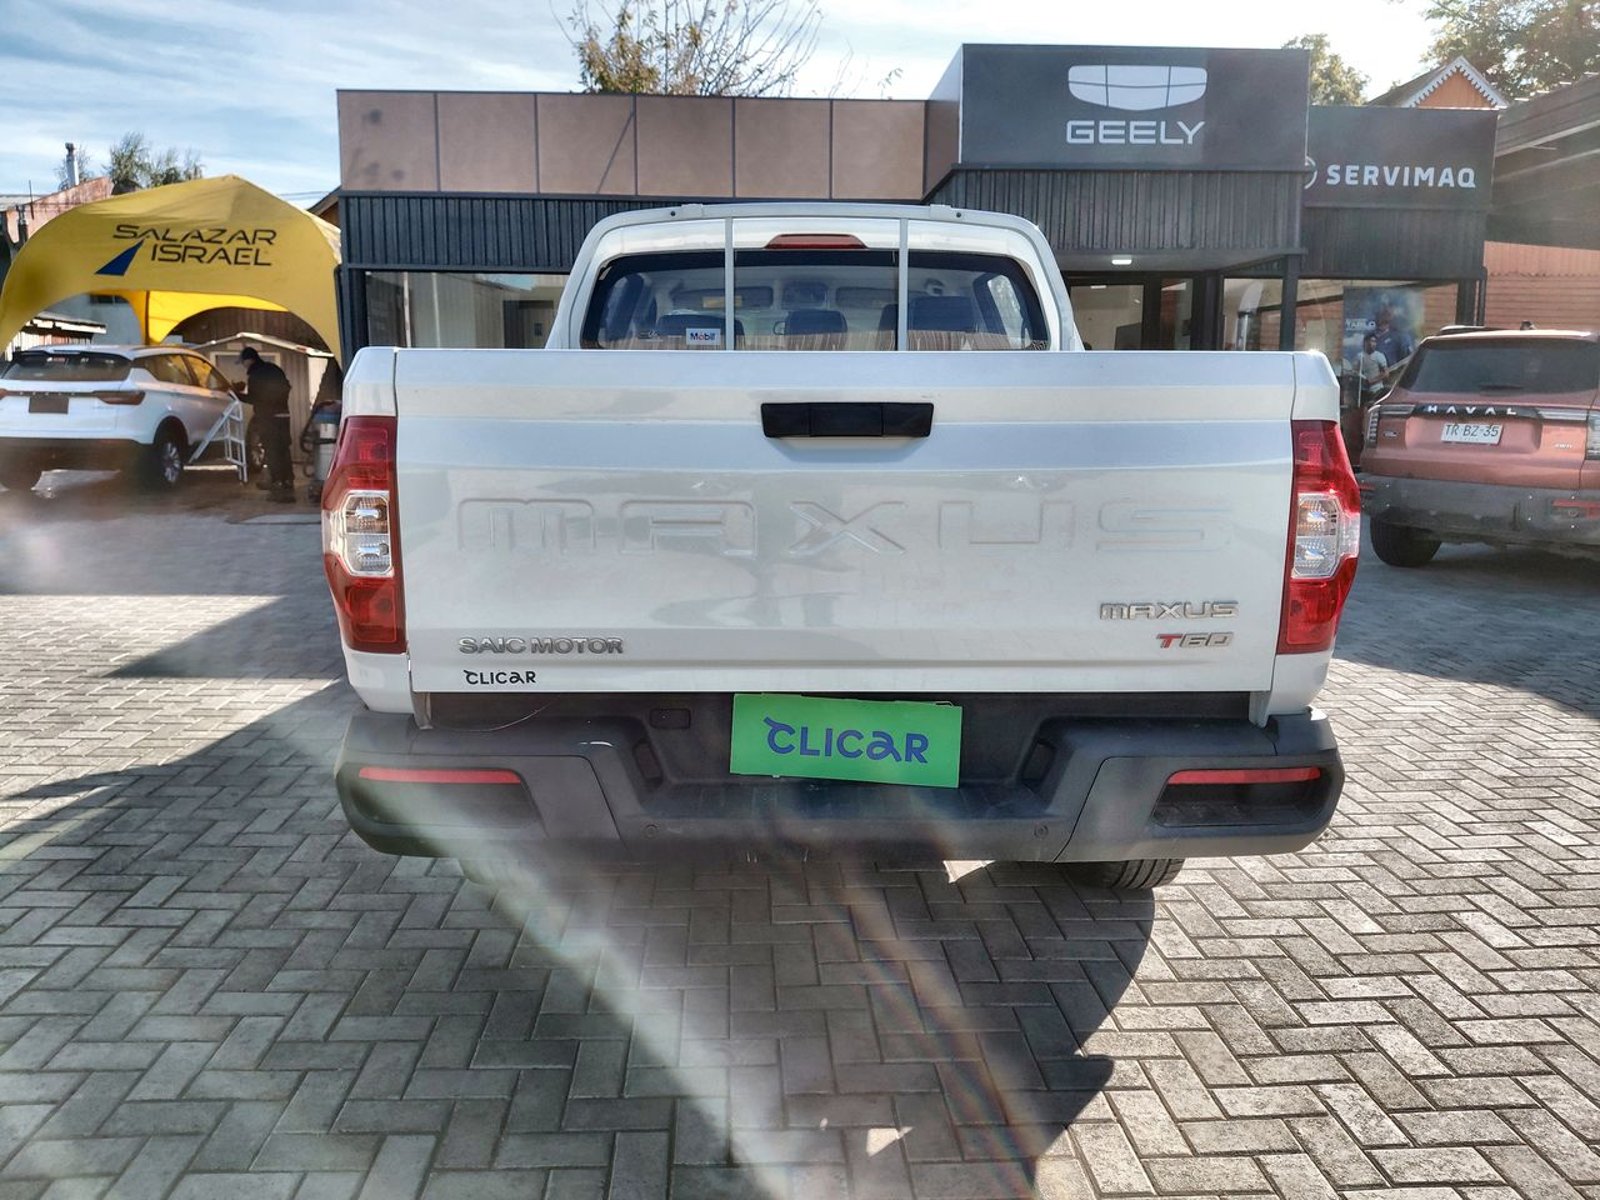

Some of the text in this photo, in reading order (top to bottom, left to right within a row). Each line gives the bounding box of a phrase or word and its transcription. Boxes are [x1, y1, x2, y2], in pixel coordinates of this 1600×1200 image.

[1066, 120, 1206, 144] GEELY
[1325, 163, 1477, 189] SERVIMAQ
[112, 224, 277, 245] SALAZAR
[151, 243, 272, 266] ISRAEL
[1426, 404, 1517, 416] HAVAL
[457, 497, 1235, 557] MAXUS
[1099, 600, 1239, 620] MAXUS
[458, 636, 624, 655] SAIC MOTOR
[1156, 631, 1235, 649] T60
